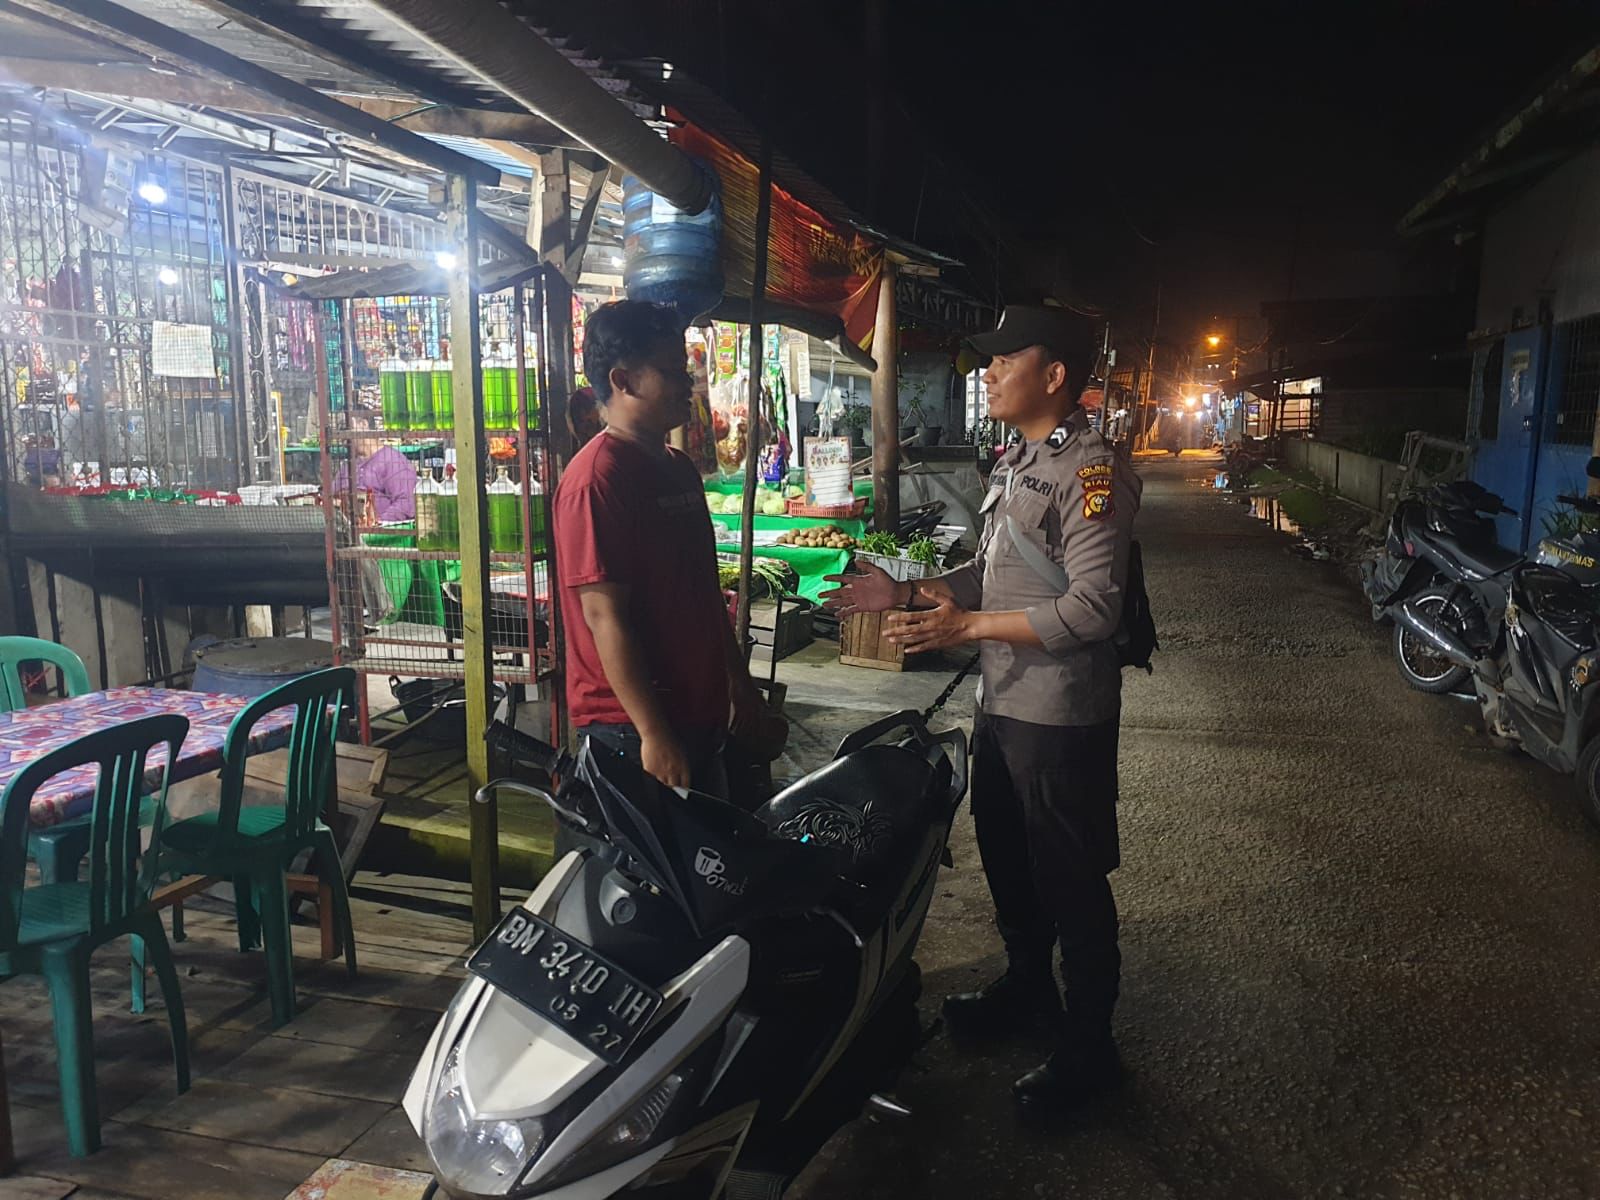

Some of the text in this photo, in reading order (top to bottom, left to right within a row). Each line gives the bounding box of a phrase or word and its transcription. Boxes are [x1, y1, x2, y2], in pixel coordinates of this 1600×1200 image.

[1019, 475, 1053, 497] POLRI
[1084, 479, 1110, 489] RIAU
[497, 915, 545, 955] BM
[540, 941, 609, 995] 3410
[550, 995, 624, 1049] 05 27
